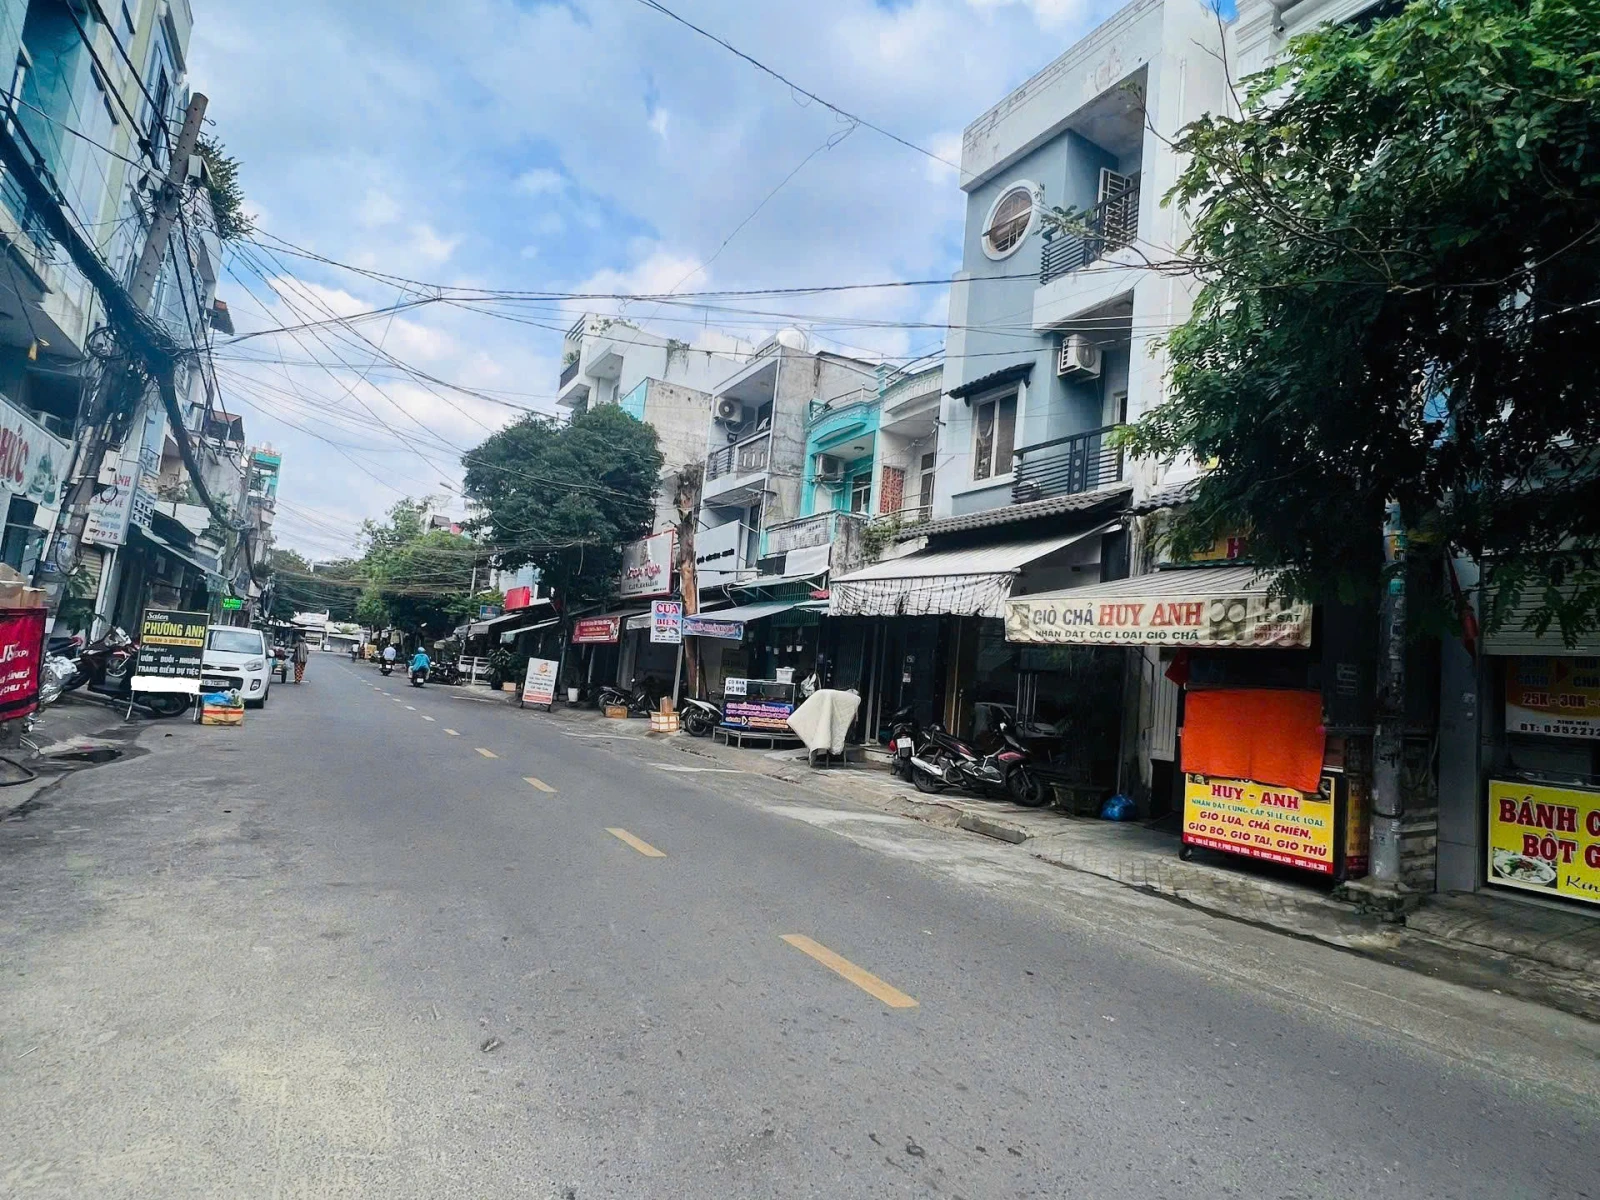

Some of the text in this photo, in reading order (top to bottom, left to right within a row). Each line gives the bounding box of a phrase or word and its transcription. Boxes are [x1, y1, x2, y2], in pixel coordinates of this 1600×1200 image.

[656, 603, 679, 614] CUA
[1033, 602, 1203, 626] GIÒ CHẢ HUY ANH
[143, 621, 205, 638] PHƯƠNG ANH
[1523, 692, 1549, 706] 25K
[1211, 784, 1244, 800] HUY
[1260, 792, 1300, 809] ANH
[1499, 794, 1578, 833] BÁNH
[1276, 838, 1299, 850] GIÒ
[1303, 843, 1327, 857] THỦ
